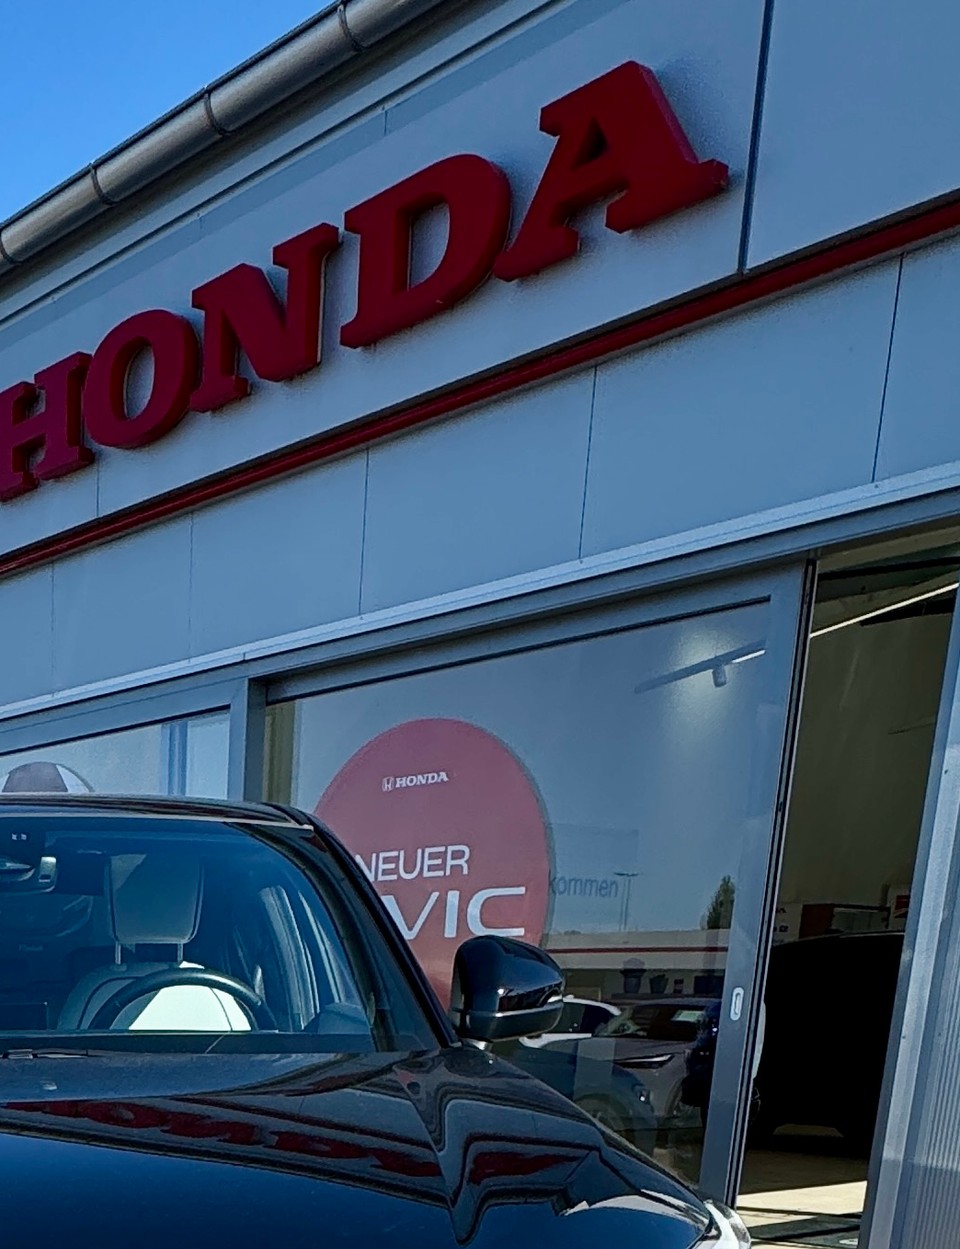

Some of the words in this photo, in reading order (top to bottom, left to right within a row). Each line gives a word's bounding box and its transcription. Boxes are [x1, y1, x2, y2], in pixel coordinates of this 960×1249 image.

[395, 771, 449, 788] HONDA
[354, 844, 471, 882] NEUER
[547, 869, 619, 898] kommen
[380, 886, 526, 940] VIC
